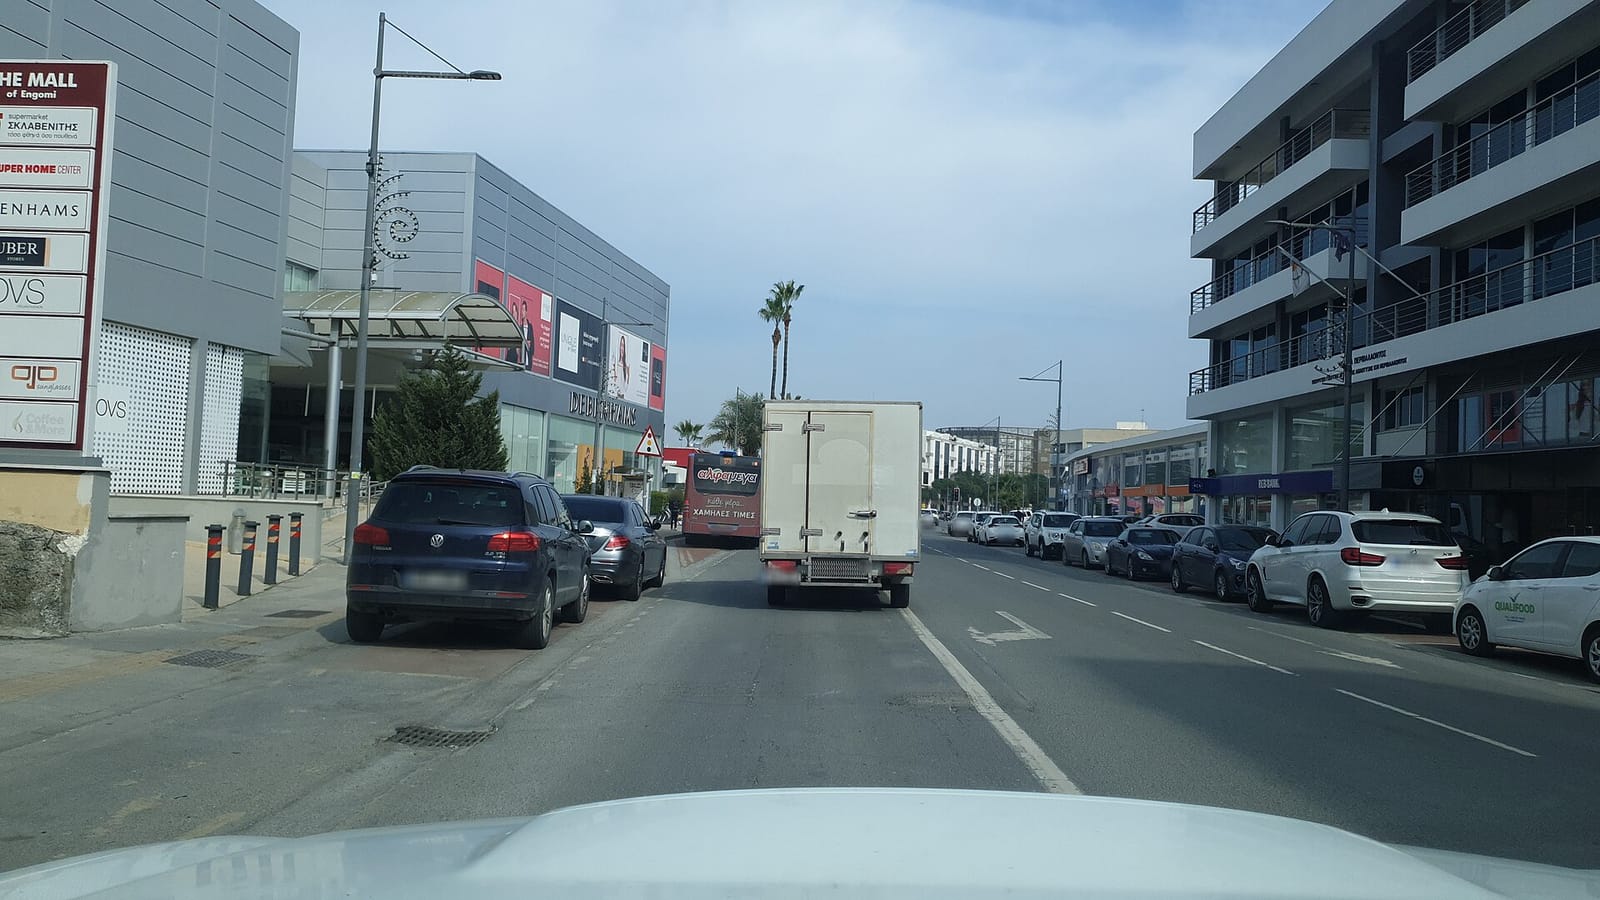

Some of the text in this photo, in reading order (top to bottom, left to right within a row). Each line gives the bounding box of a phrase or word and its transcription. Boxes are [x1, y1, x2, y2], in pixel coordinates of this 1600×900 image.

[27, 72, 78, 88] MALL
[6, 90, 57, 100] of Engomi
[8, 121, 78, 131] ΣΚΛΑΒΕΝΙΤΗΣ
[25, 165, 56, 174] HOME
[57, 165, 81, 174] CENTER
[0, 203, 79, 217] ENHAMS
[96, 398, 127, 418] OVS
[693, 508, 756, 519] ΧΑΜΗΛΕΣ ΤΙΜΕΣ
[1494, 601, 1536, 614] QUALIFOOD
